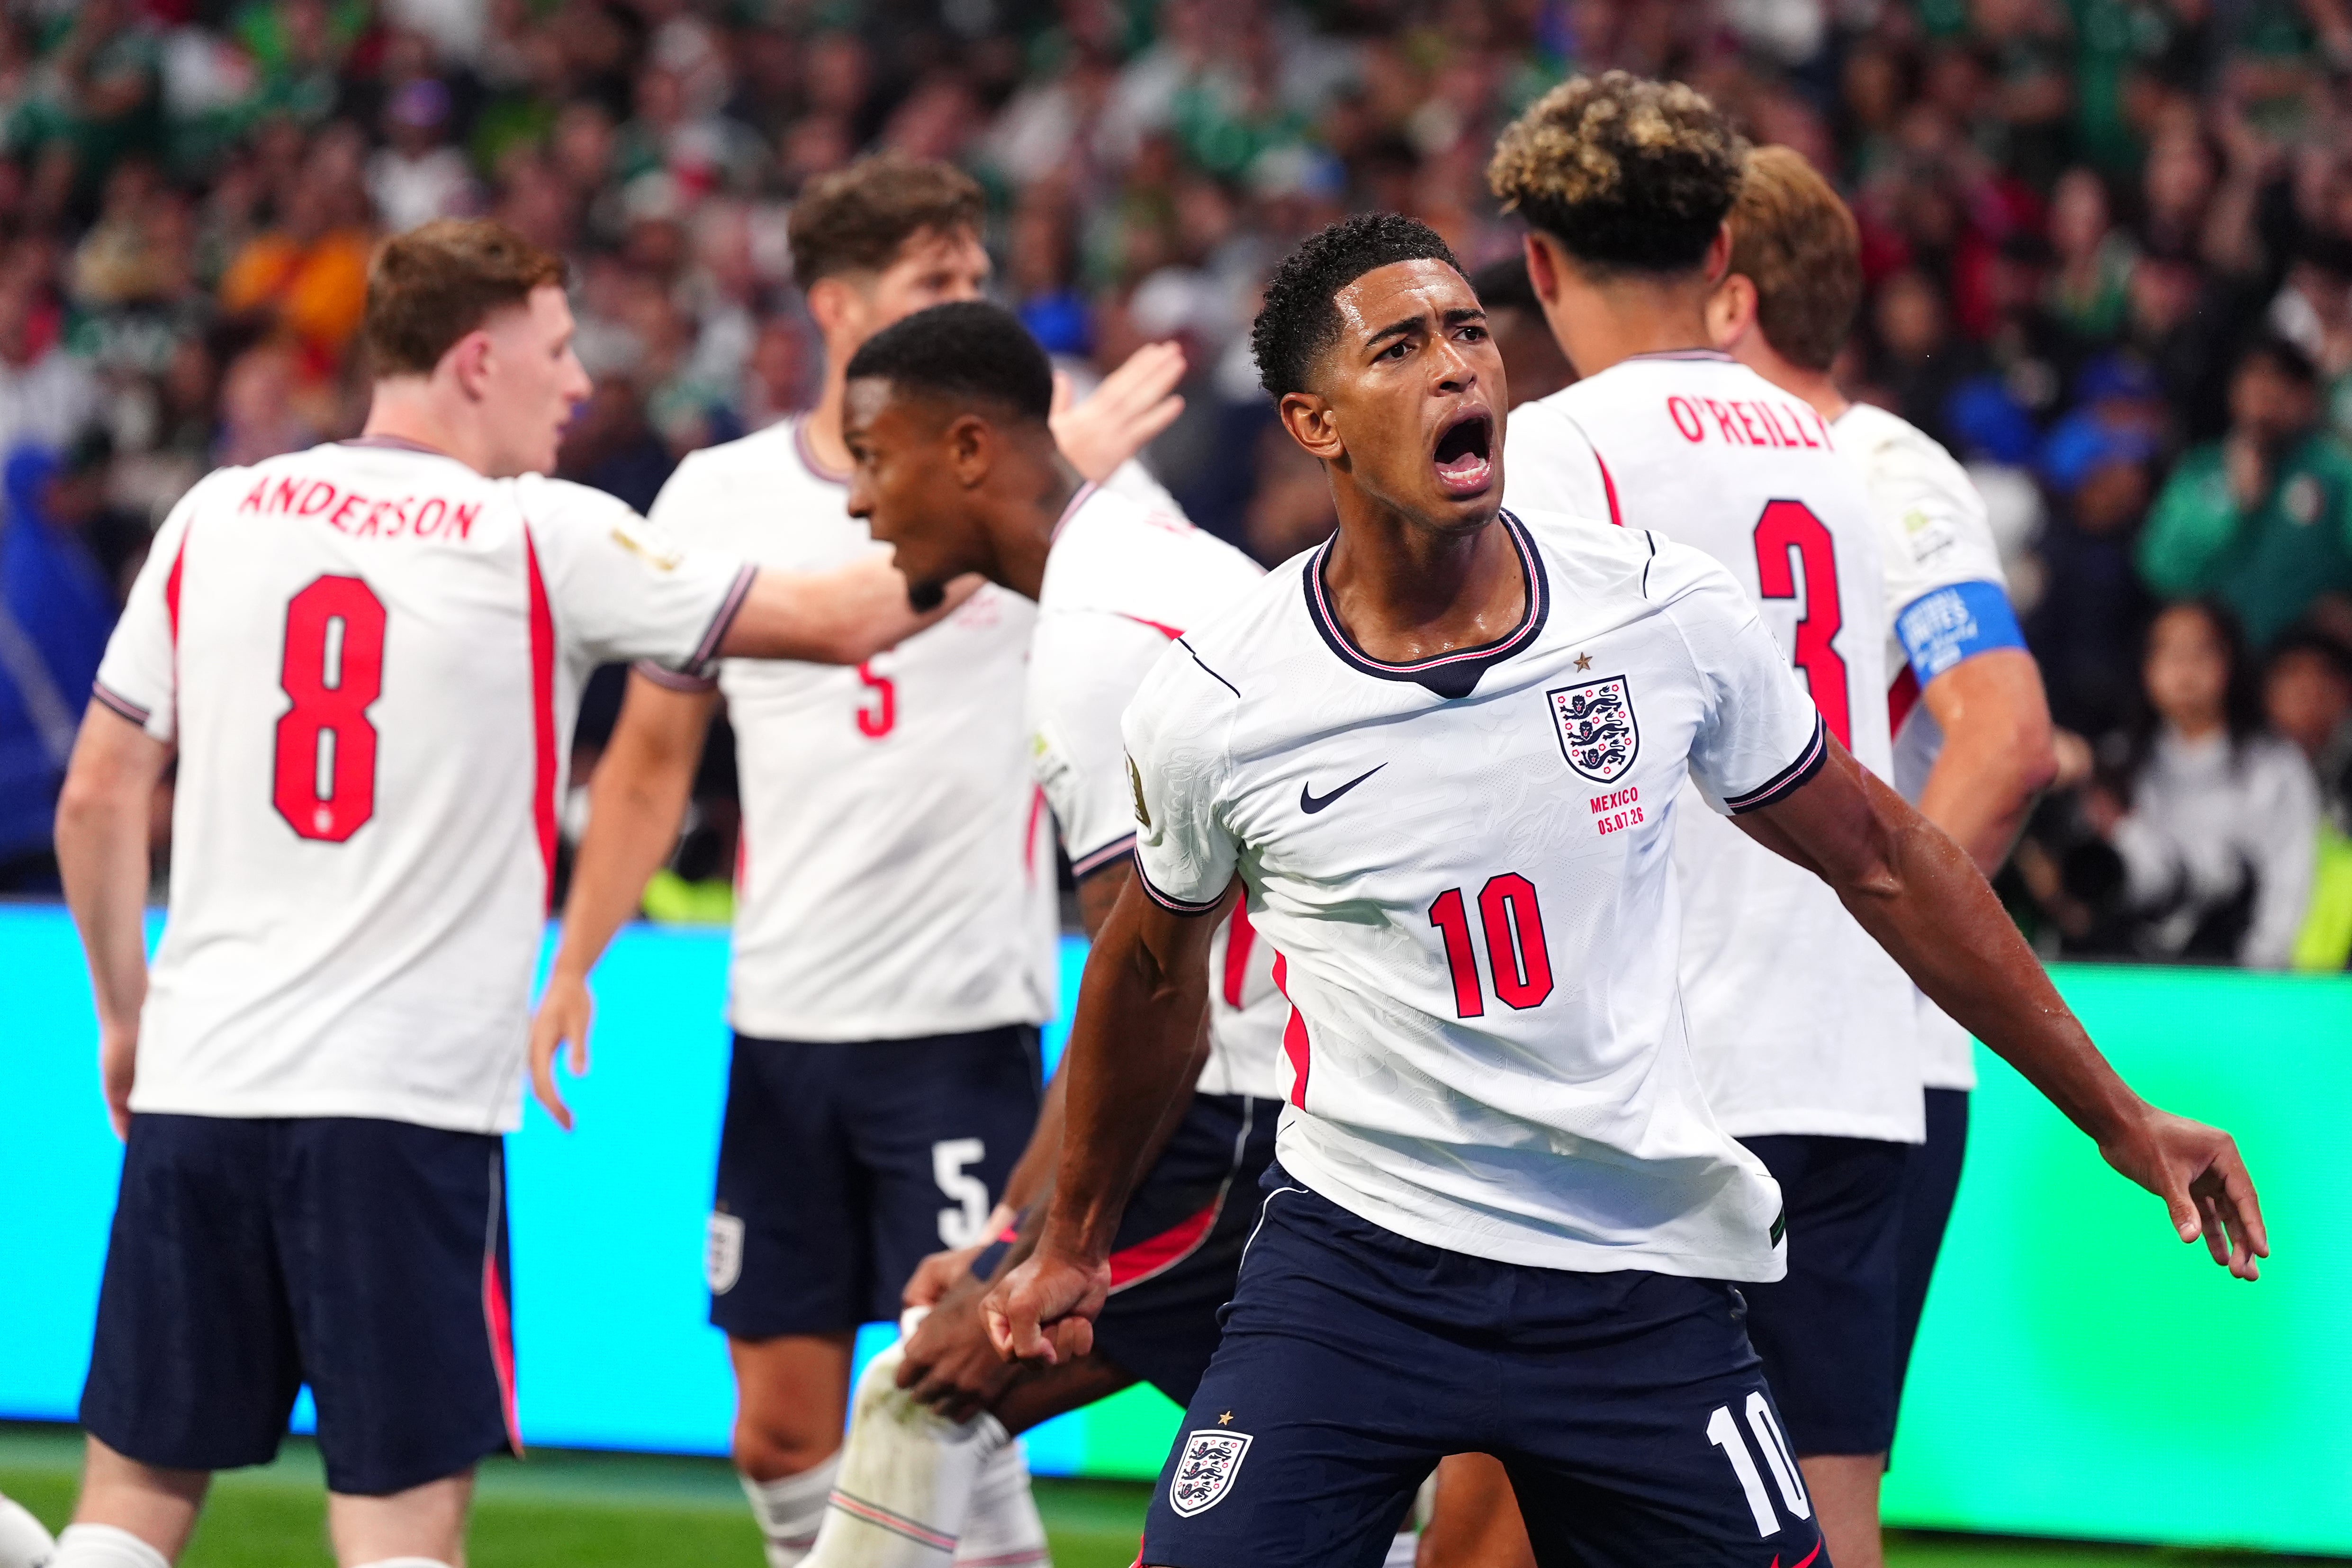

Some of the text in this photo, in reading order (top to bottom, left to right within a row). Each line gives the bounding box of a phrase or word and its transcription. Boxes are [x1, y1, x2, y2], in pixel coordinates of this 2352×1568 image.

[237, 476, 482, 539] ANDERSON
[1753, 499, 1852, 754] 3
[273, 574, 387, 843] 8
[856, 650, 893, 738] 5
[1590, 786, 1638, 814] MEXICO
[1598, 807, 1643, 835] 05.07.26
[1428, 872, 1554, 1018] 10
[931, 1137, 990, 1251] 5
[1706, 1390, 1811, 1538] 10
